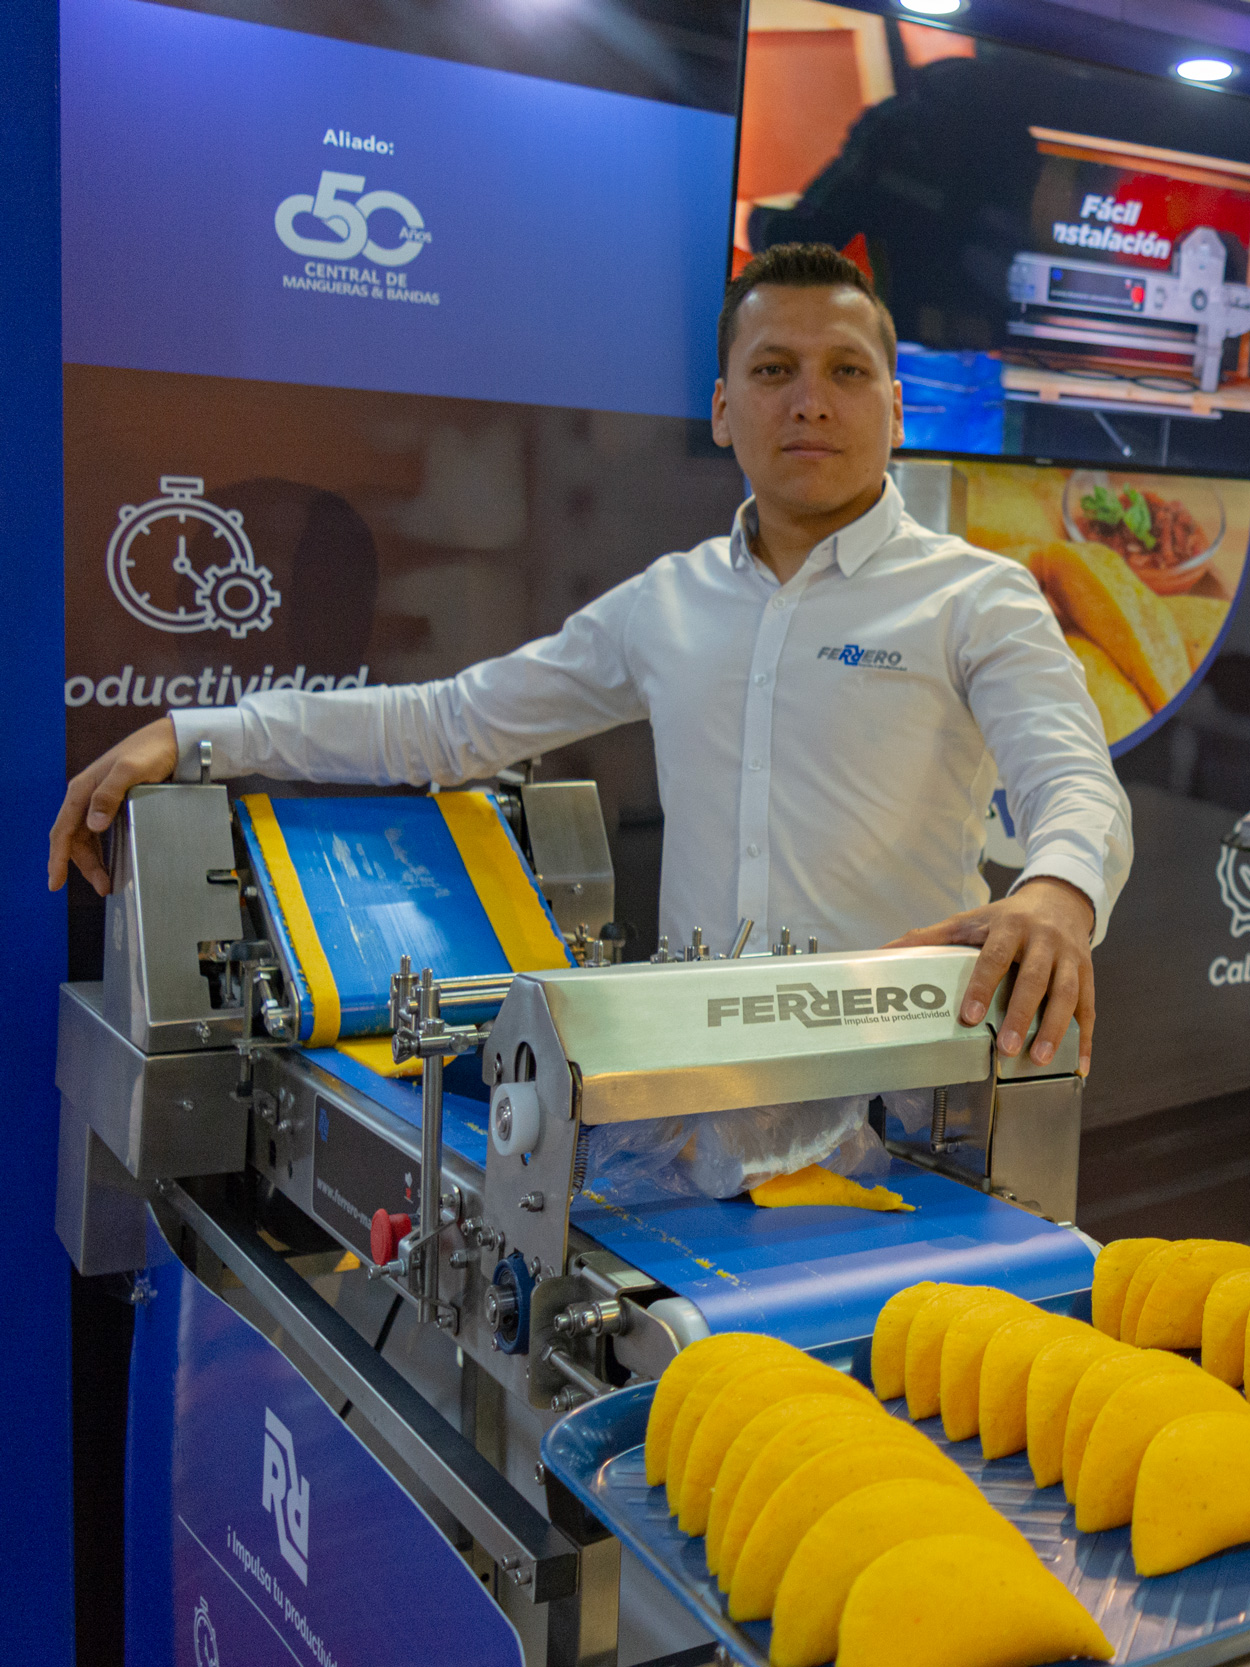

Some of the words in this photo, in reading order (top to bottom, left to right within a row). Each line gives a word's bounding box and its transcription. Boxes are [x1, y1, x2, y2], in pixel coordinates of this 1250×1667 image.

[322, 128, 395, 156] Aliado:
[1080, 194, 1143, 226] Fácil
[1053, 222, 1172, 260] nstalación
[304, 261, 380, 285] CENTRAL
[386, 271, 407, 288] DE
[282, 275, 368, 298] MANGUERAS
[371, 287, 383, 300] &
[386, 287, 440, 306] BANDAS
[817, 644, 902, 667] FERRERO
[65, 664, 369, 708] oductividad
[707, 982, 947, 1029] FERRERO
[843, 1015, 880, 1026] Impulsa
[881, 1014, 891, 1022] tu
[891, 1009, 951, 1022] productividad
[273, 1577, 284, 1609] tu
